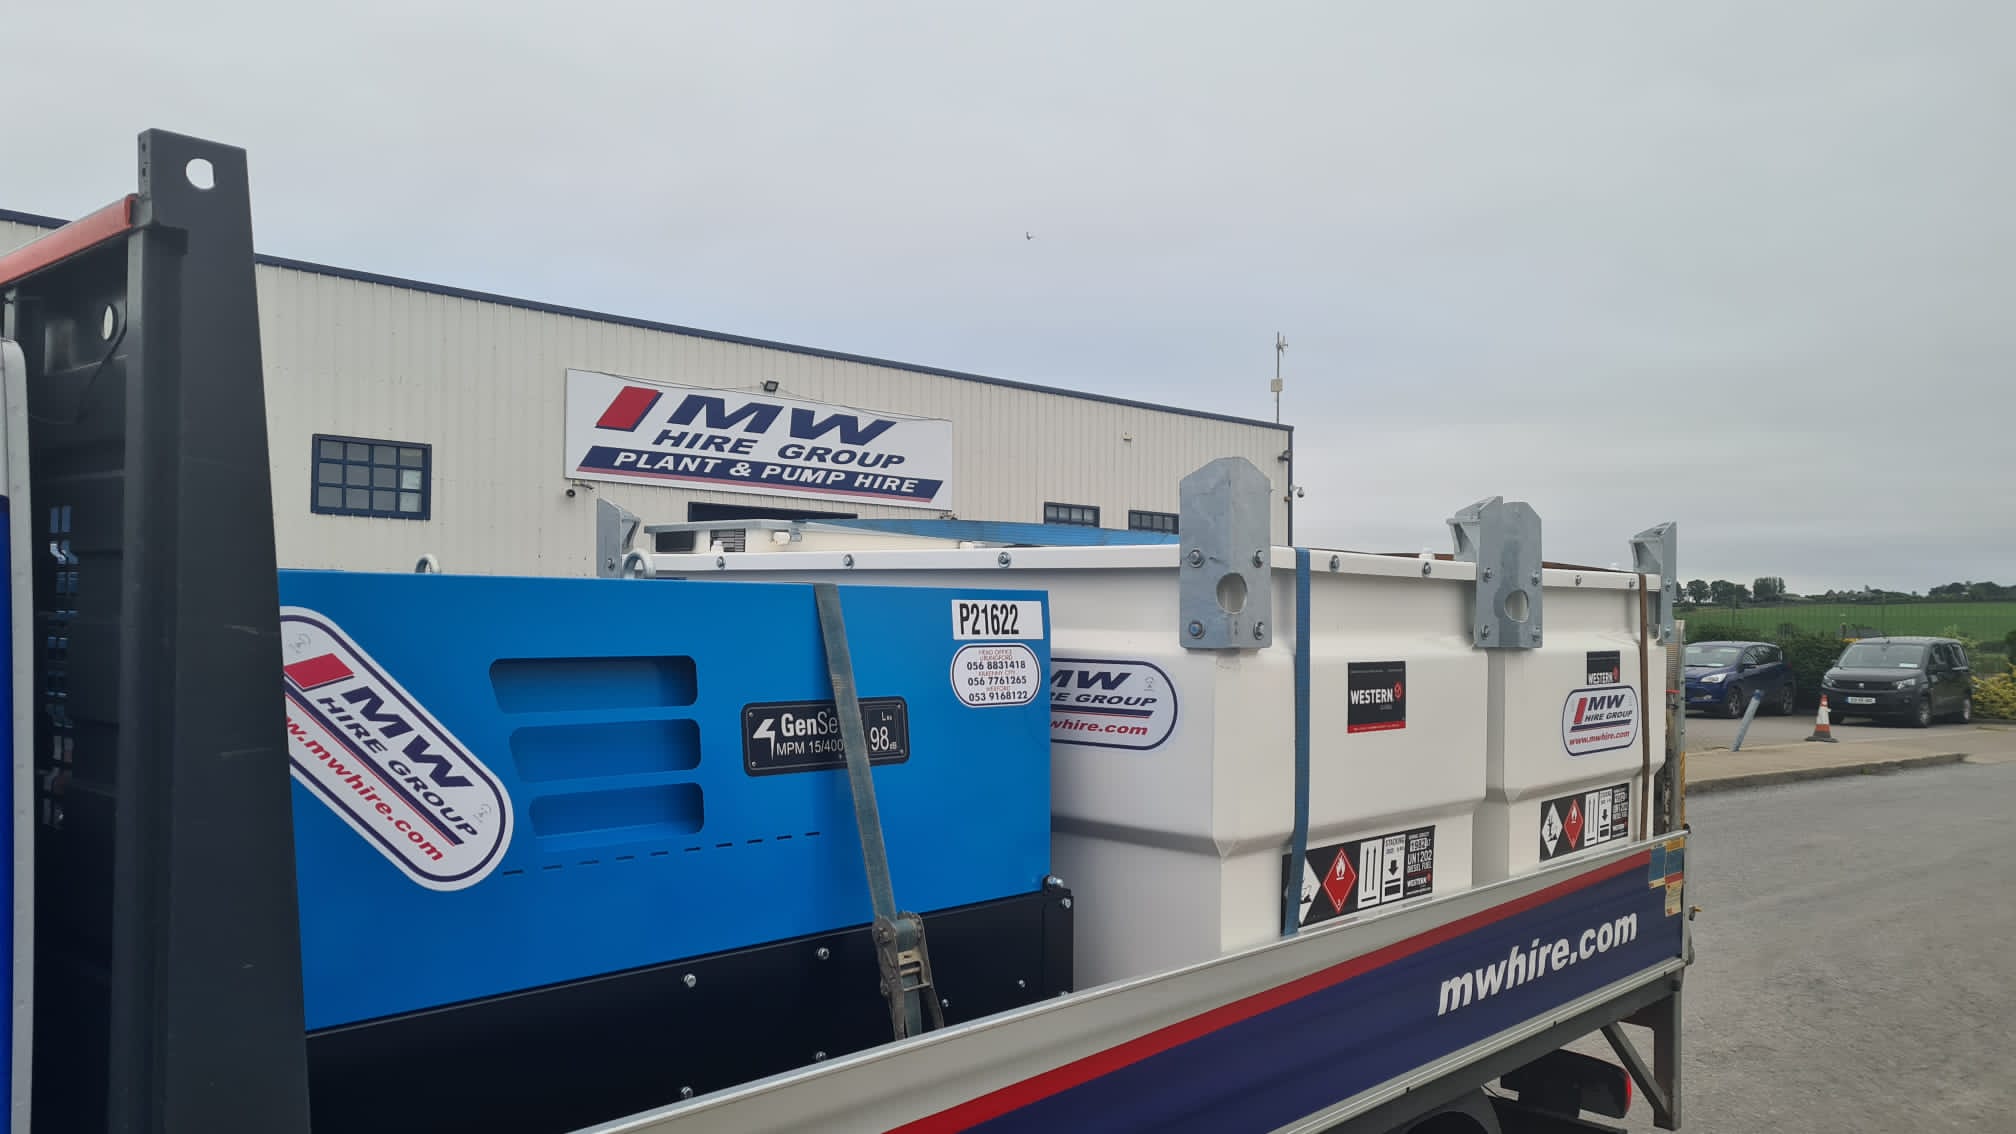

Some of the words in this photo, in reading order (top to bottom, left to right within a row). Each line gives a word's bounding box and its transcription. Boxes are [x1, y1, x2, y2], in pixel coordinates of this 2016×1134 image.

[666, 394, 898, 446] MW
[652, 429, 758, 456] HIRE
[777, 443, 905, 470] GROUP
[613, 451, 722, 474] PLANT
[729, 461, 752, 477] &
[761, 465, 846, 486] PUMP
[854, 474, 919, 494] HIRE
[959, 603, 1019, 635] P21622
[967, 661, 984, 671] 056
[987, 660, 1026, 670] 8831418
[968, 677, 985, 686] 056
[988, 675, 1027, 685] 7761265
[969, 692, 986, 702] 053
[989, 690, 1028, 700] 9168122
[1075, 694, 1157, 707] GROUP
[1350, 687, 1393, 705] WESTERN
[1588, 694, 1626, 712] MW
[1584, 713, 1605, 723] HIRE
[1606, 710, 1632, 720] GROUP
[341, 685, 474, 788] MW
[776, 741, 805, 757] MPM
[316, 697, 388, 755] HIRE
[388, 760, 478, 836] GROUP
[1437, 912, 1638, 1016] mwhire.com
